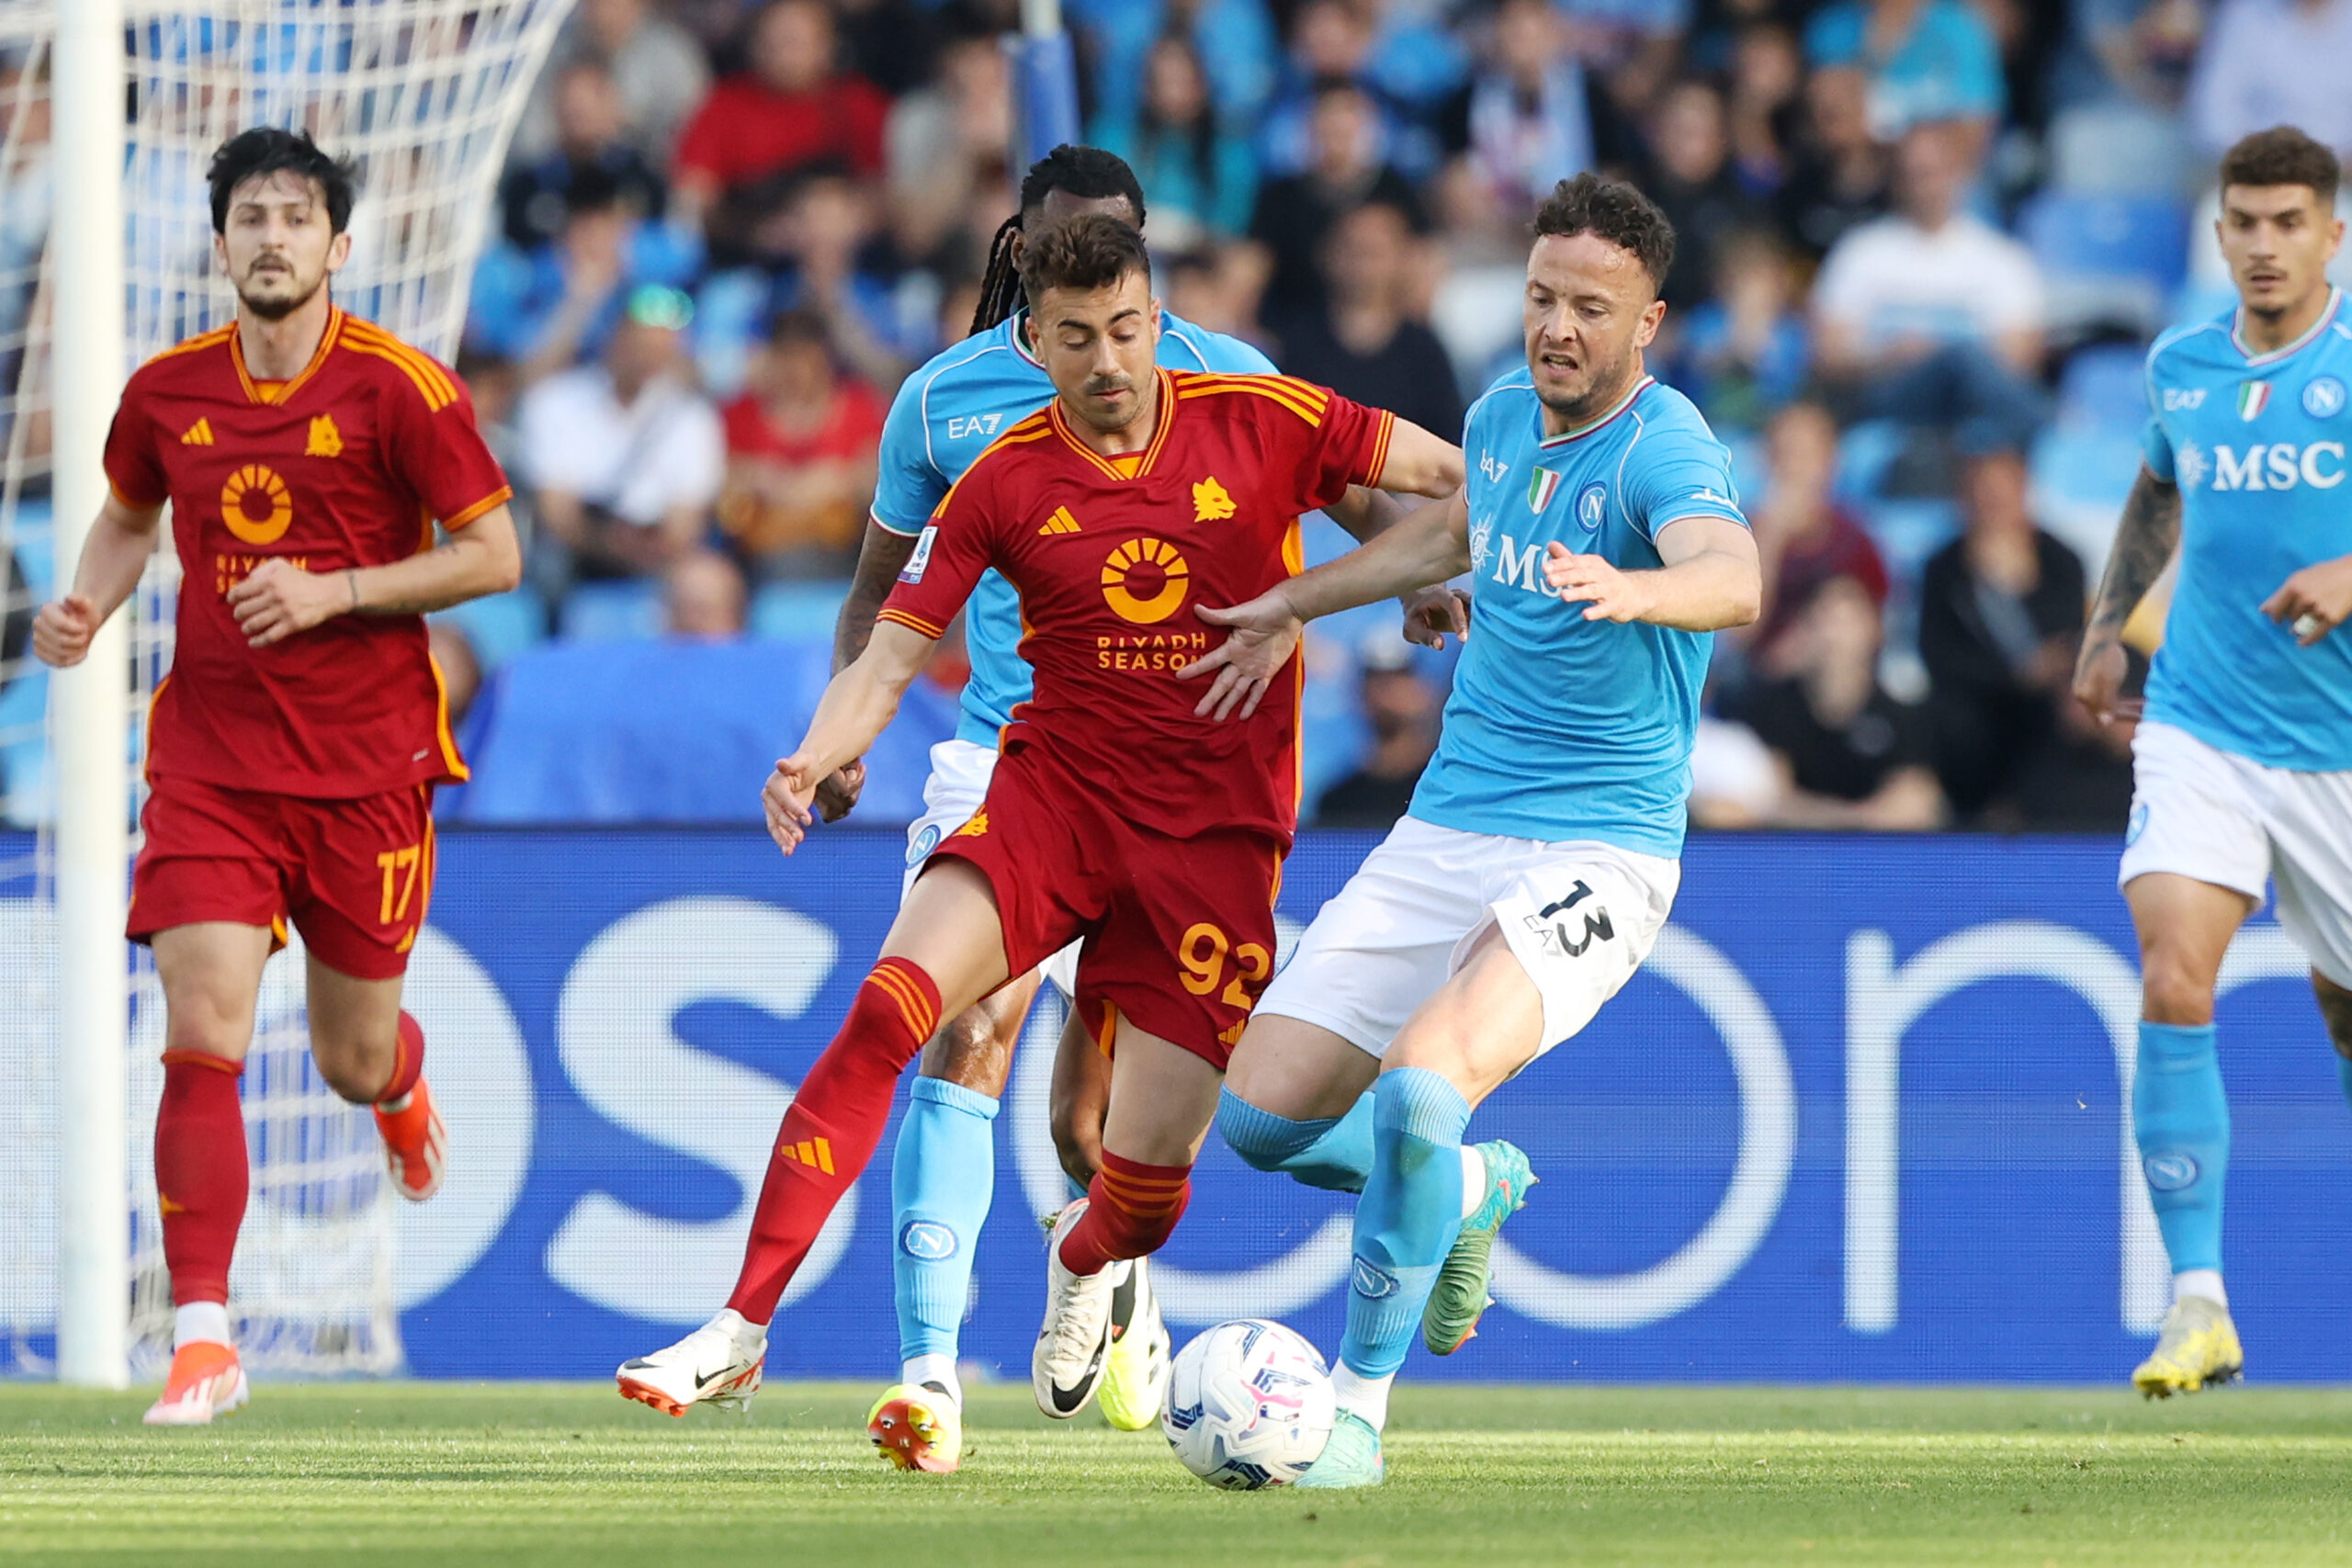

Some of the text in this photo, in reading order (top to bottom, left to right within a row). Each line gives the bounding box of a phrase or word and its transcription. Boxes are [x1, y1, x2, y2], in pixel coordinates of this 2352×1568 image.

[2164, 389, 2206, 411] EA7
[947, 412, 1003, 439] EA7
[2211, 441, 2346, 491] MSC
[216, 554, 307, 573] RIYH
[1492, 533, 1574, 597] MS
[1097, 631, 1205, 649] RIYADH
[377, 843, 420, 925] 17
[1538, 879, 1614, 957] 13
[1178, 922, 1270, 1011] 92
